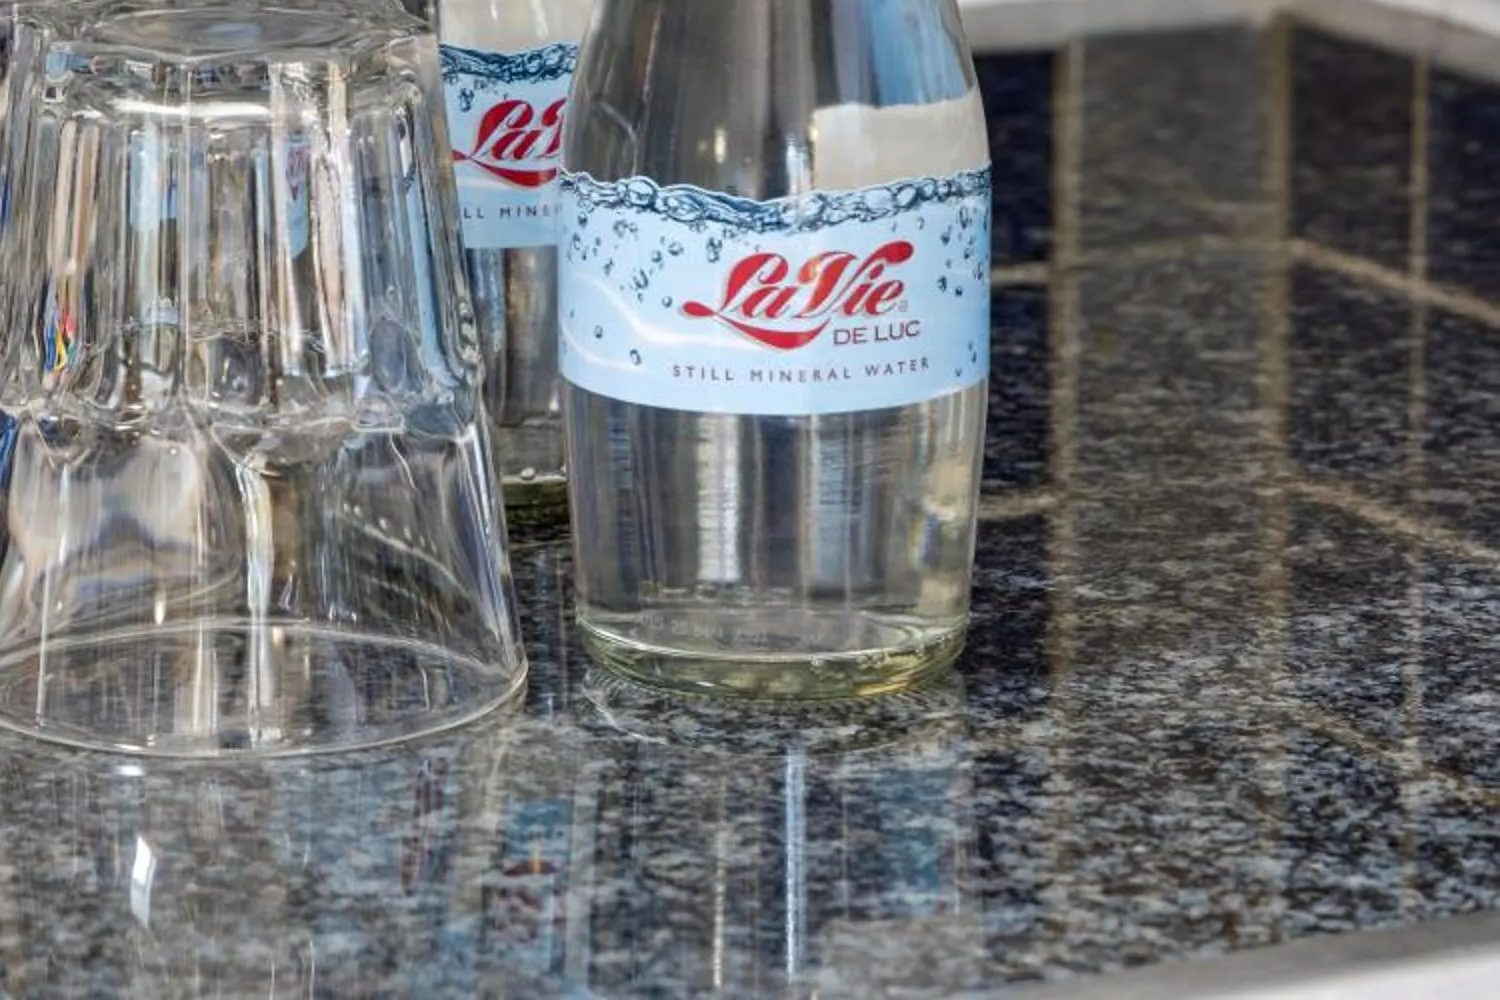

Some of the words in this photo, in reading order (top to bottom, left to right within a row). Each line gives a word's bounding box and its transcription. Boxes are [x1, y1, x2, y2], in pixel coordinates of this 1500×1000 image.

[832, 326, 868, 346] DE
[874, 319, 921, 342] LUC
[672, 364, 735, 382] STILL
[750, 364, 852, 384] MINERAL
[864, 356, 930, 379] WATER
